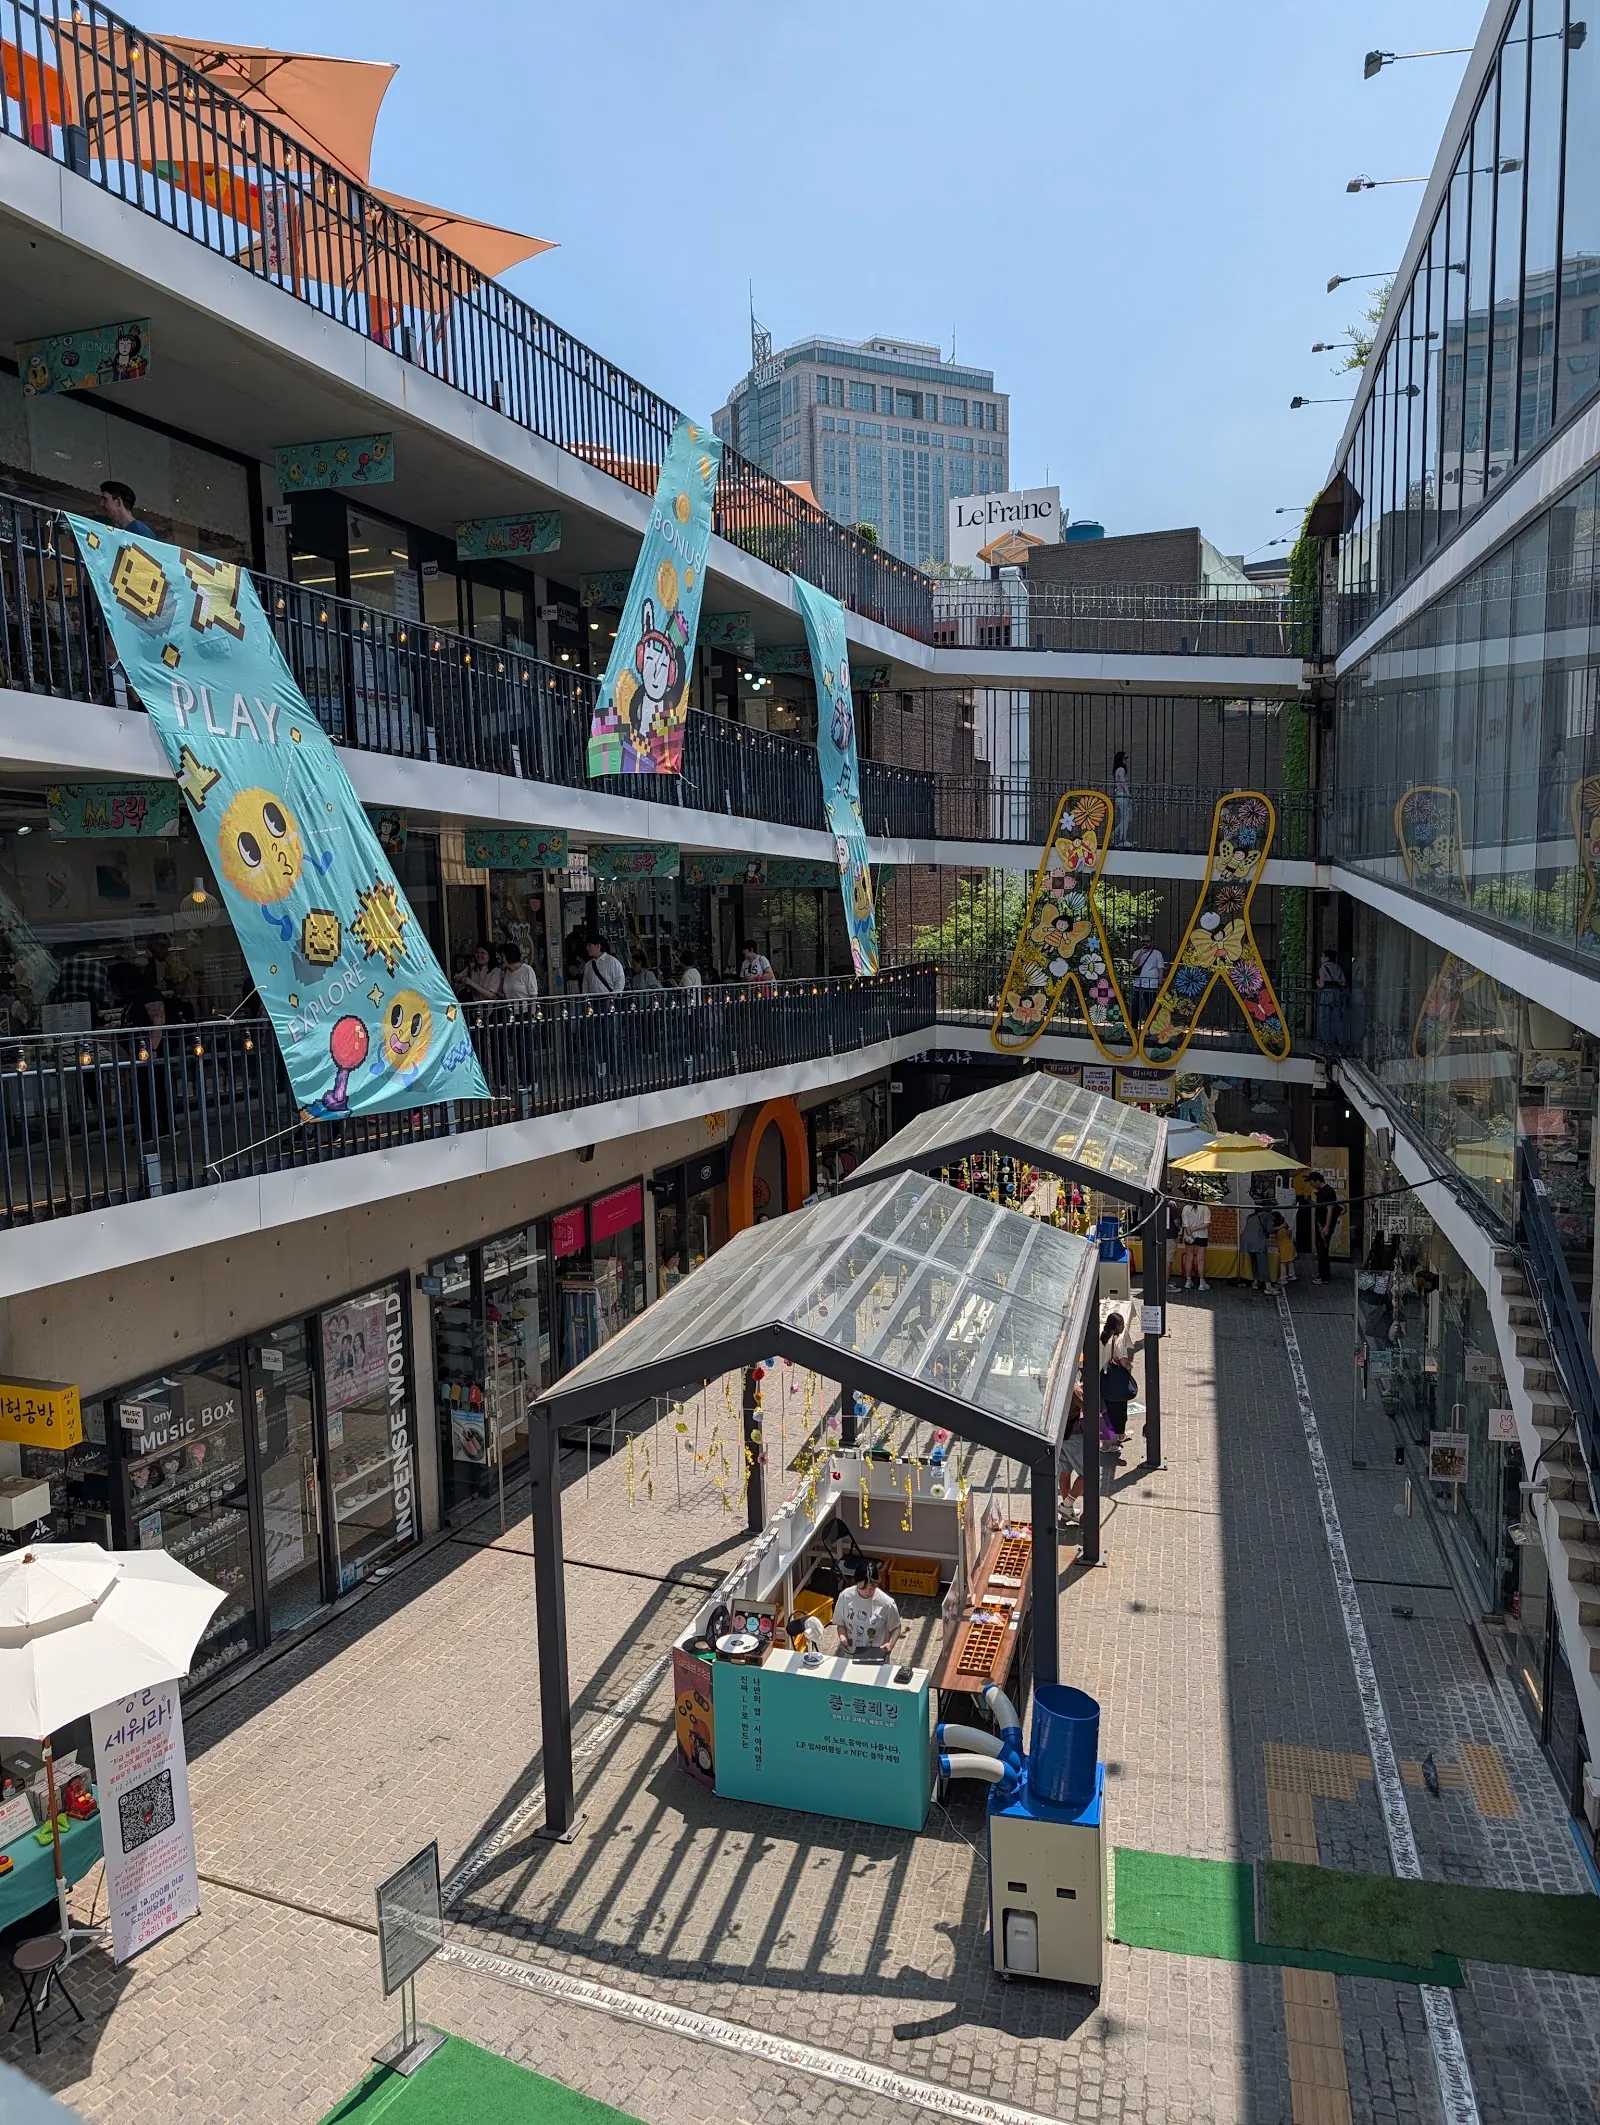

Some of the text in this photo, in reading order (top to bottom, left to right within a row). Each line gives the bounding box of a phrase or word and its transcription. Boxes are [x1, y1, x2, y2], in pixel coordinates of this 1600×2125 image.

[81, 340, 115, 354] BONUS
[303, 476, 324, 486] PLAY
[654, 508, 702, 574] BONUS
[171, 678, 282, 744] PLAY
[597, 881, 616, 898] 조개
[287, 959, 366, 1044] EXPLORE
[934, 1052, 944, 1063] &
[948, 1051, 973, 1064] 사주
[125, 1417, 139, 1425] BOX
[153, 1408, 173, 1424] ony
[386, 1291, 413, 1542] INCENSE WORLD
[139, 1417, 196, 1454] Music
[201, 1399, 235, 1427] Box
[104, 1698, 172, 1752] 세워라!
[823, 1735, 831, 1743] 이
[795, 1740, 806, 1748] LP
[850, 1749, 869, 1758] NFC
